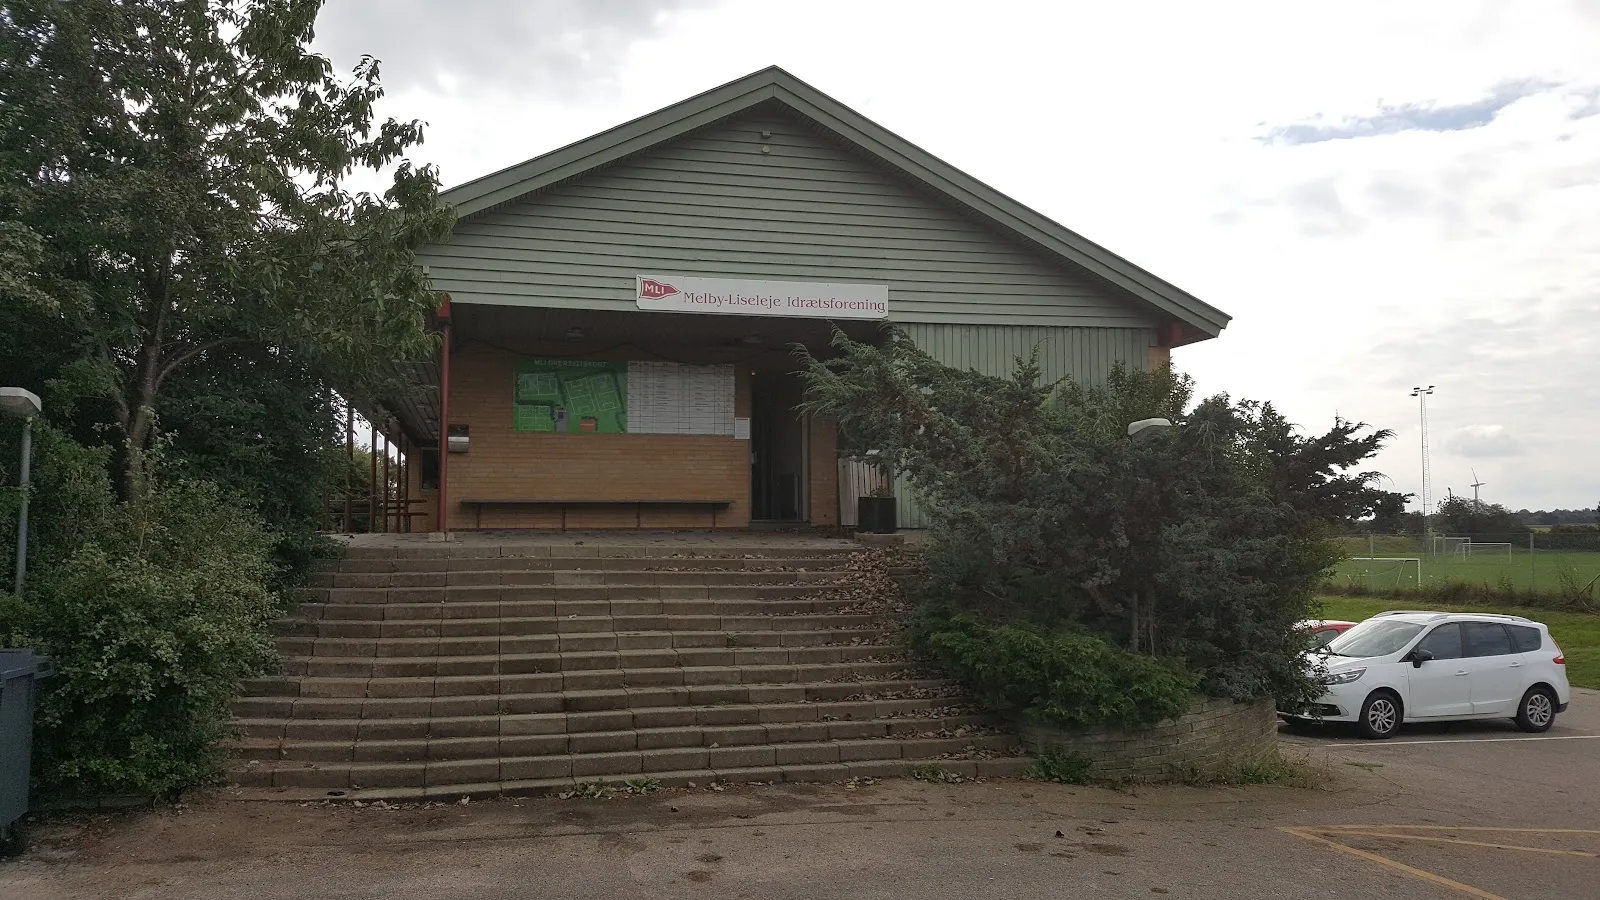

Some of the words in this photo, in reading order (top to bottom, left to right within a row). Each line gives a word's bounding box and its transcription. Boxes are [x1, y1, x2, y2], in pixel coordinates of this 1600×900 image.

[644, 283, 665, 295] MLI
[683, 292, 781, 309] Melby-Liseleje
[787, 296, 886, 313] Idrætsforening
